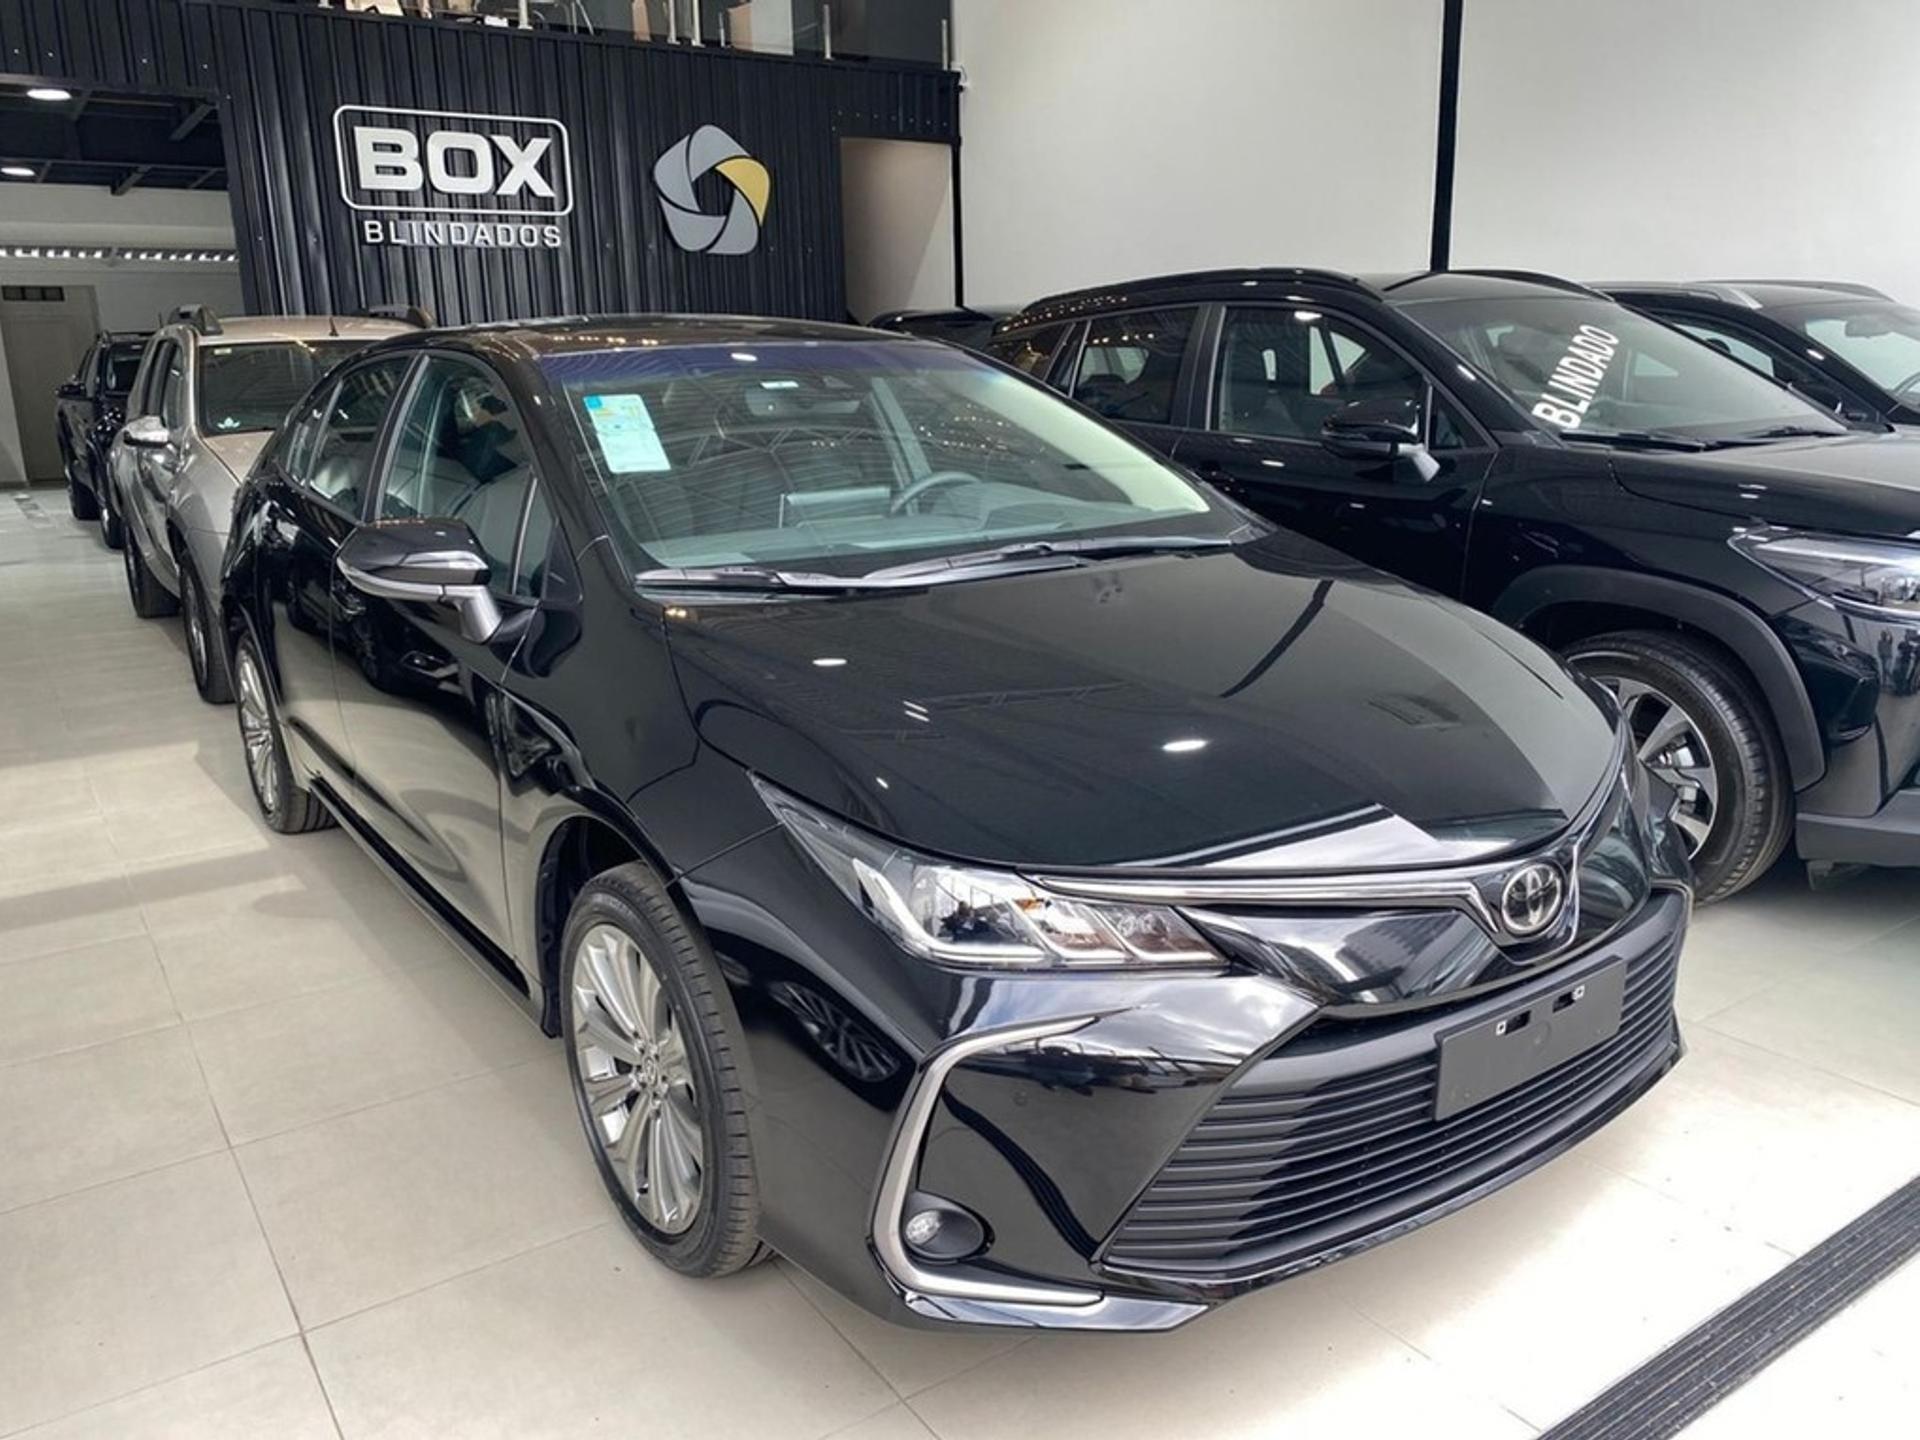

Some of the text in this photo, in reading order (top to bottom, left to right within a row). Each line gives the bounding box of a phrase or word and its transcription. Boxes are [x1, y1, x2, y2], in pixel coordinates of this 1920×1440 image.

[353, 126, 556, 198] BOX
[364, 220, 562, 248] BLINDADOS
[1531, 324, 1620, 430] BLINDADO
